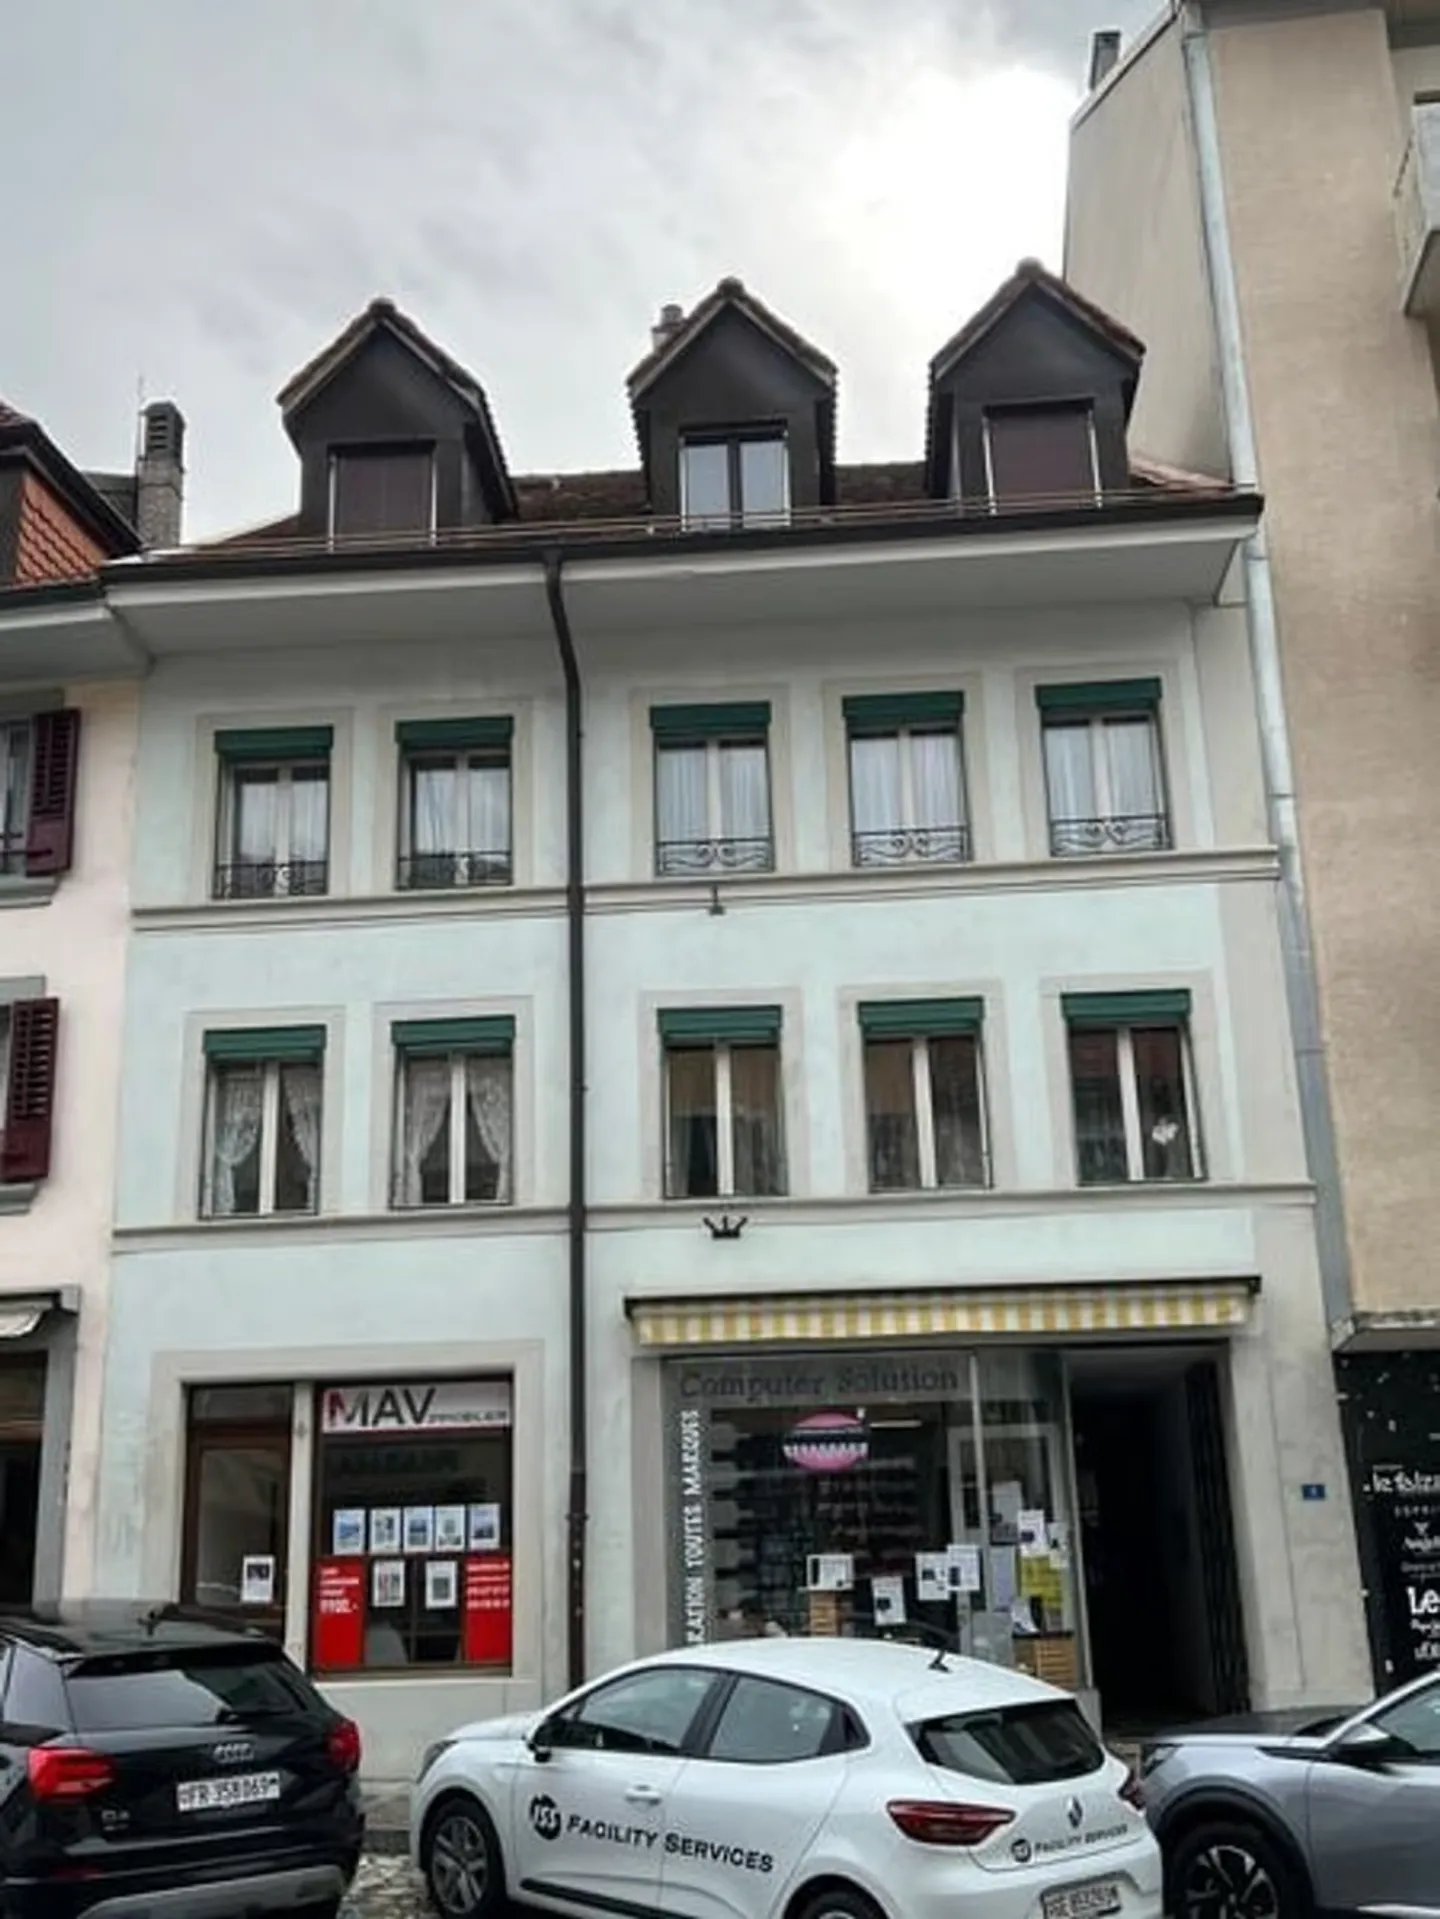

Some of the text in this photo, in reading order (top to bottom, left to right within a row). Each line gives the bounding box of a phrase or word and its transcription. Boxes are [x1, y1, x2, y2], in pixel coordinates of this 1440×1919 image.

[680, 1364, 958, 1400] Computer Solution
[329, 1387, 436, 1427] MAV
[566, 1814, 774, 1873] FACILITY SERVICES
